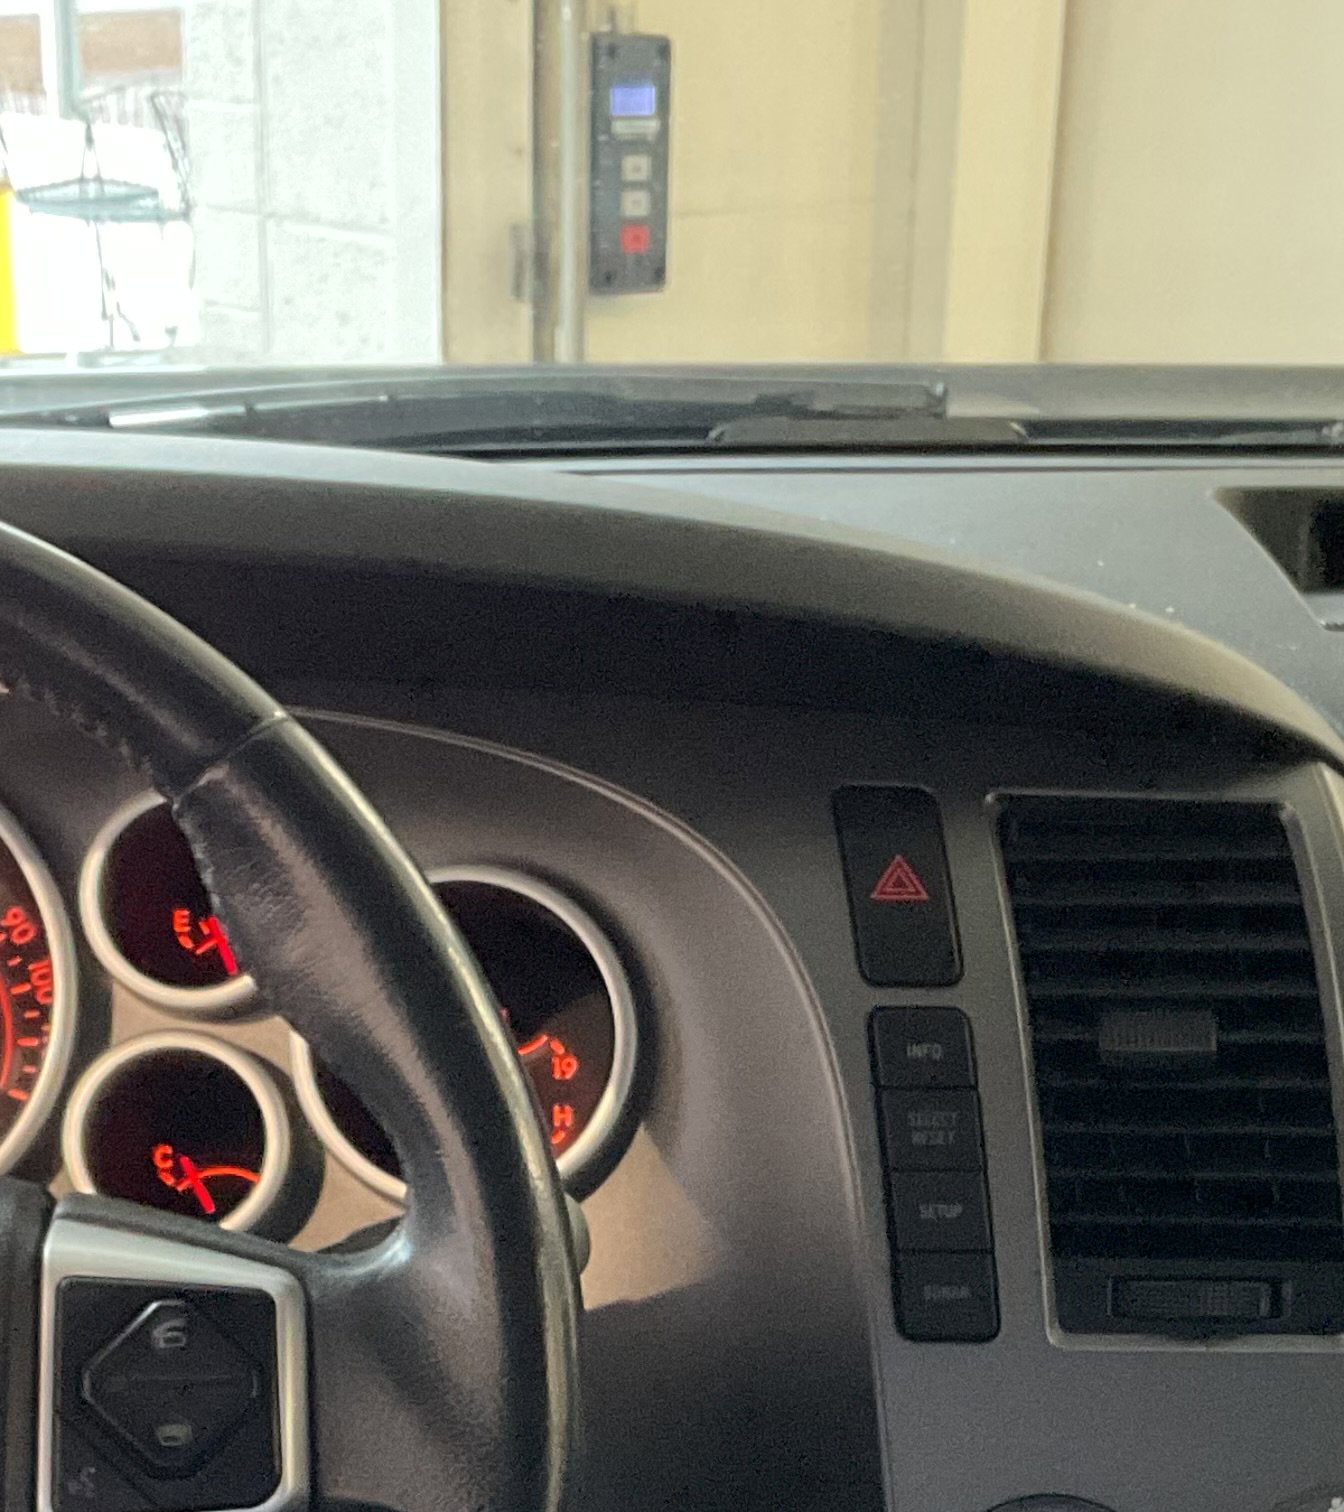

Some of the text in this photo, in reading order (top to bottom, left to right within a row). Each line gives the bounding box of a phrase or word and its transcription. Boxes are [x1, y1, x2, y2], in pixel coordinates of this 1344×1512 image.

[0, 906, 36, 944] 90
[172, 910, 191, 932] E
[552, 1054, 578, 1080] 19
[553, 1105, 573, 1127] H
[154, 1145, 173, 1169] C
